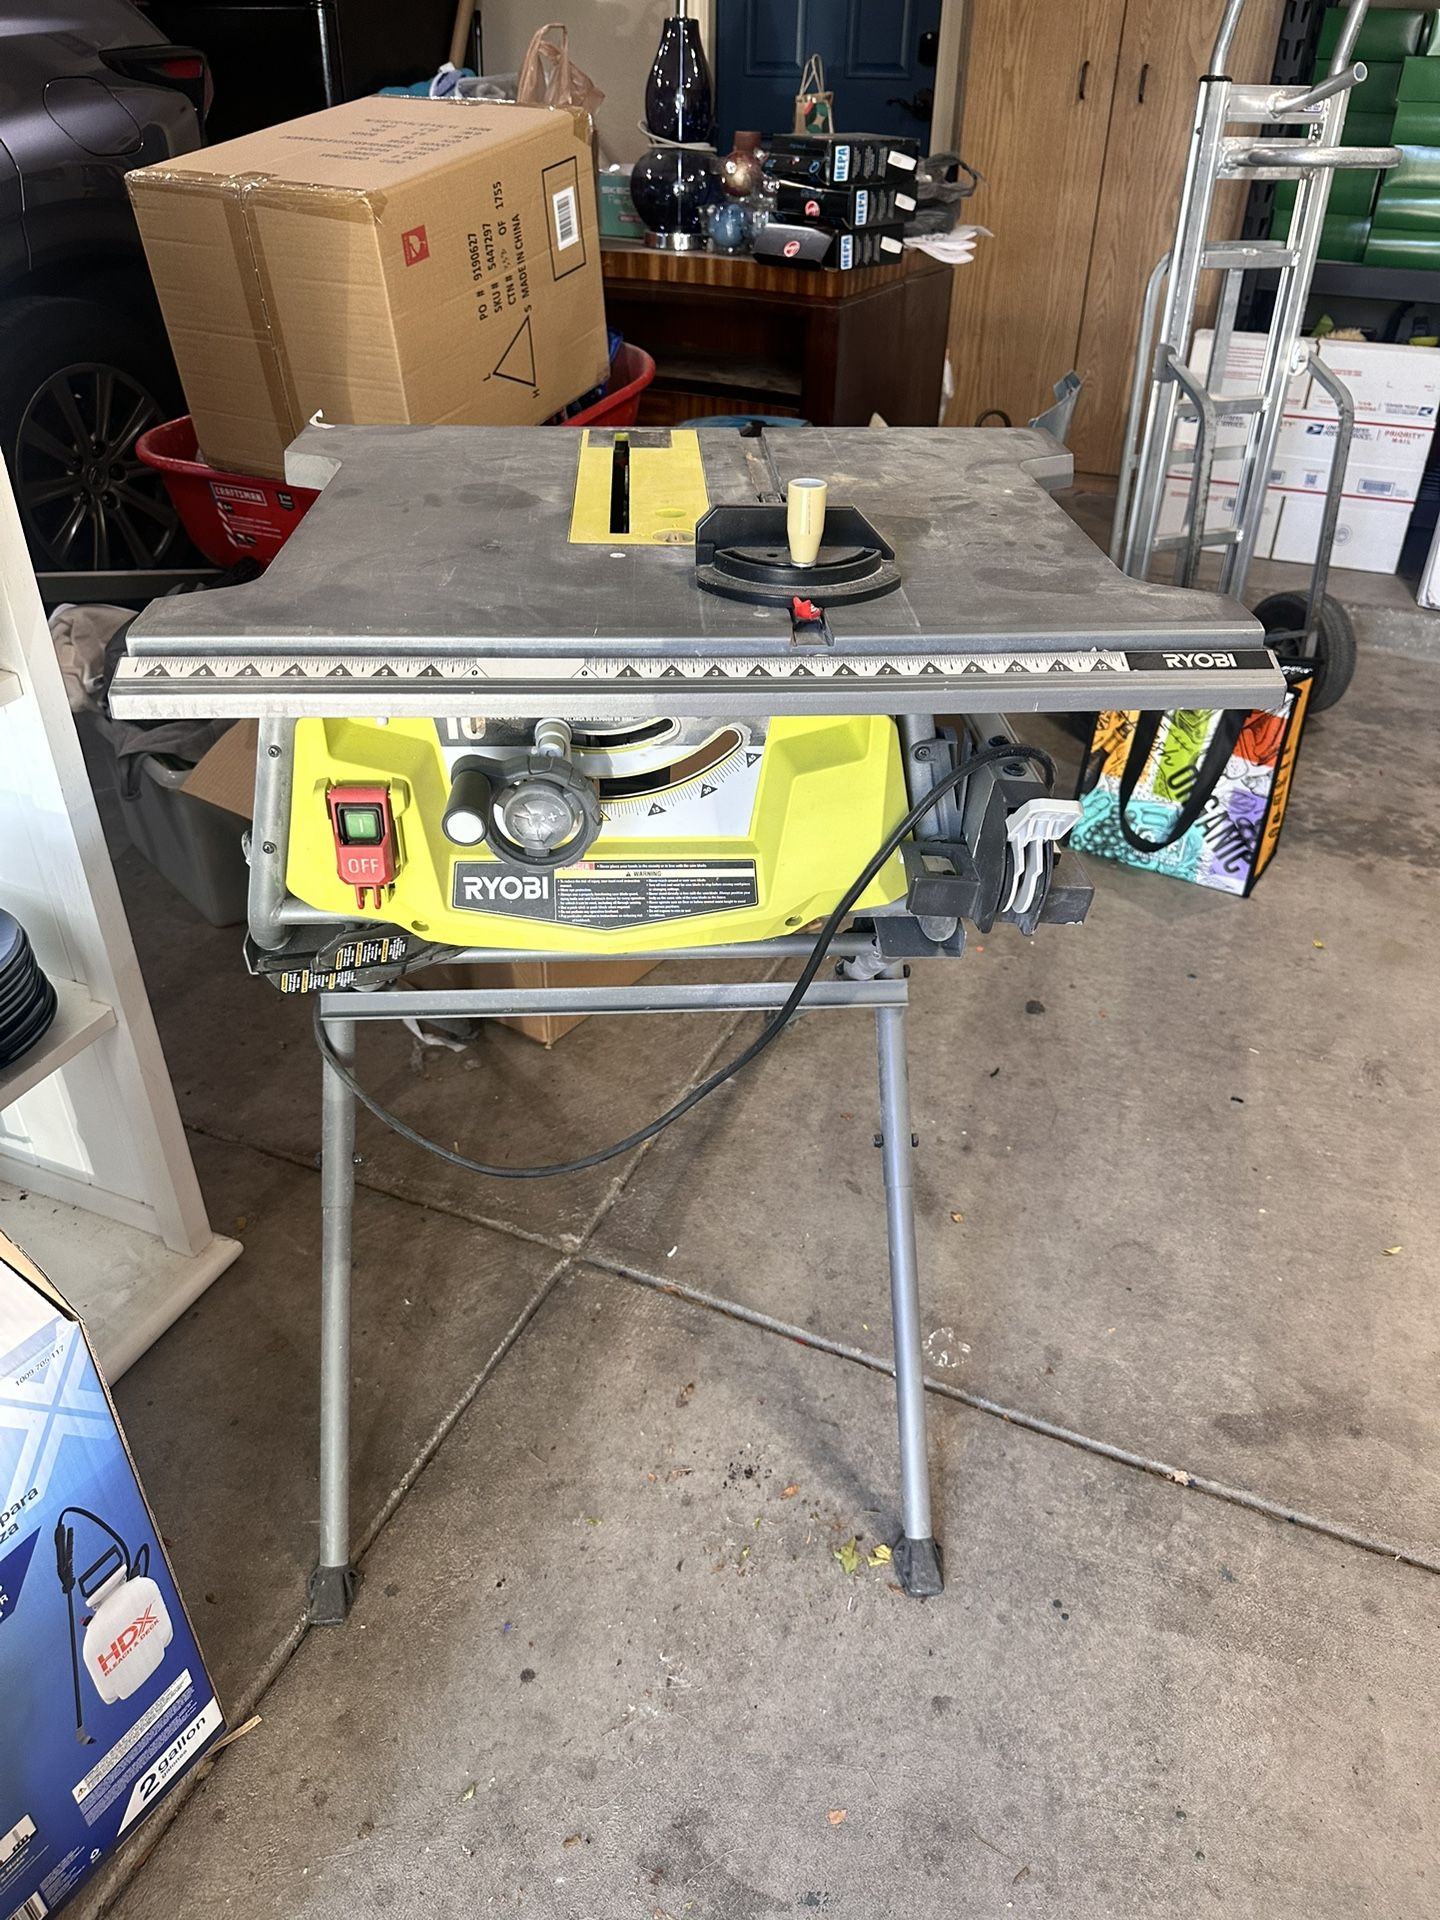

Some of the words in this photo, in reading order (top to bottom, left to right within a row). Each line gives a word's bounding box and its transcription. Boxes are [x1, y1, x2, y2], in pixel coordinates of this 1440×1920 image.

[836, 147, 848, 180] HEPA
[492, 181, 504, 210] 1755
[857, 192, 866, 224] HEPA
[497, 220, 507, 236] OF
[511, 213, 524, 250] CHINA
[467, 233, 482, 281] 9190627
[482, 223, 496, 271] 5447297
[516, 250, 526, 264] IN
[842, 237, 850, 268] HEPA
[506, 283, 516, 306] CTN
[516, 264, 529, 299] MADE
[478, 304, 488, 321] PO
[492, 291, 502, 313] SKU
[214, 486, 263, 502] CRAFTSMAN
[1096, 663, 1108, 671] 12
[1162, 653, 1238, 668] RYOBI
[348, 858, 379, 874] OFF
[463, 876, 549, 900] RYOBI
[14, 1368, 35, 1387] 1009
[0, 1488, 39, 1526] para
[97, 1604, 157, 1673] HDX
[104, 1647, 133, 1677] BLEACH
[140, 1619, 160, 1641] DECK
[138, 1772, 160, 1801] 2
[158, 1717, 206, 1774] gallon
[161, 1749, 188, 1779] galones
